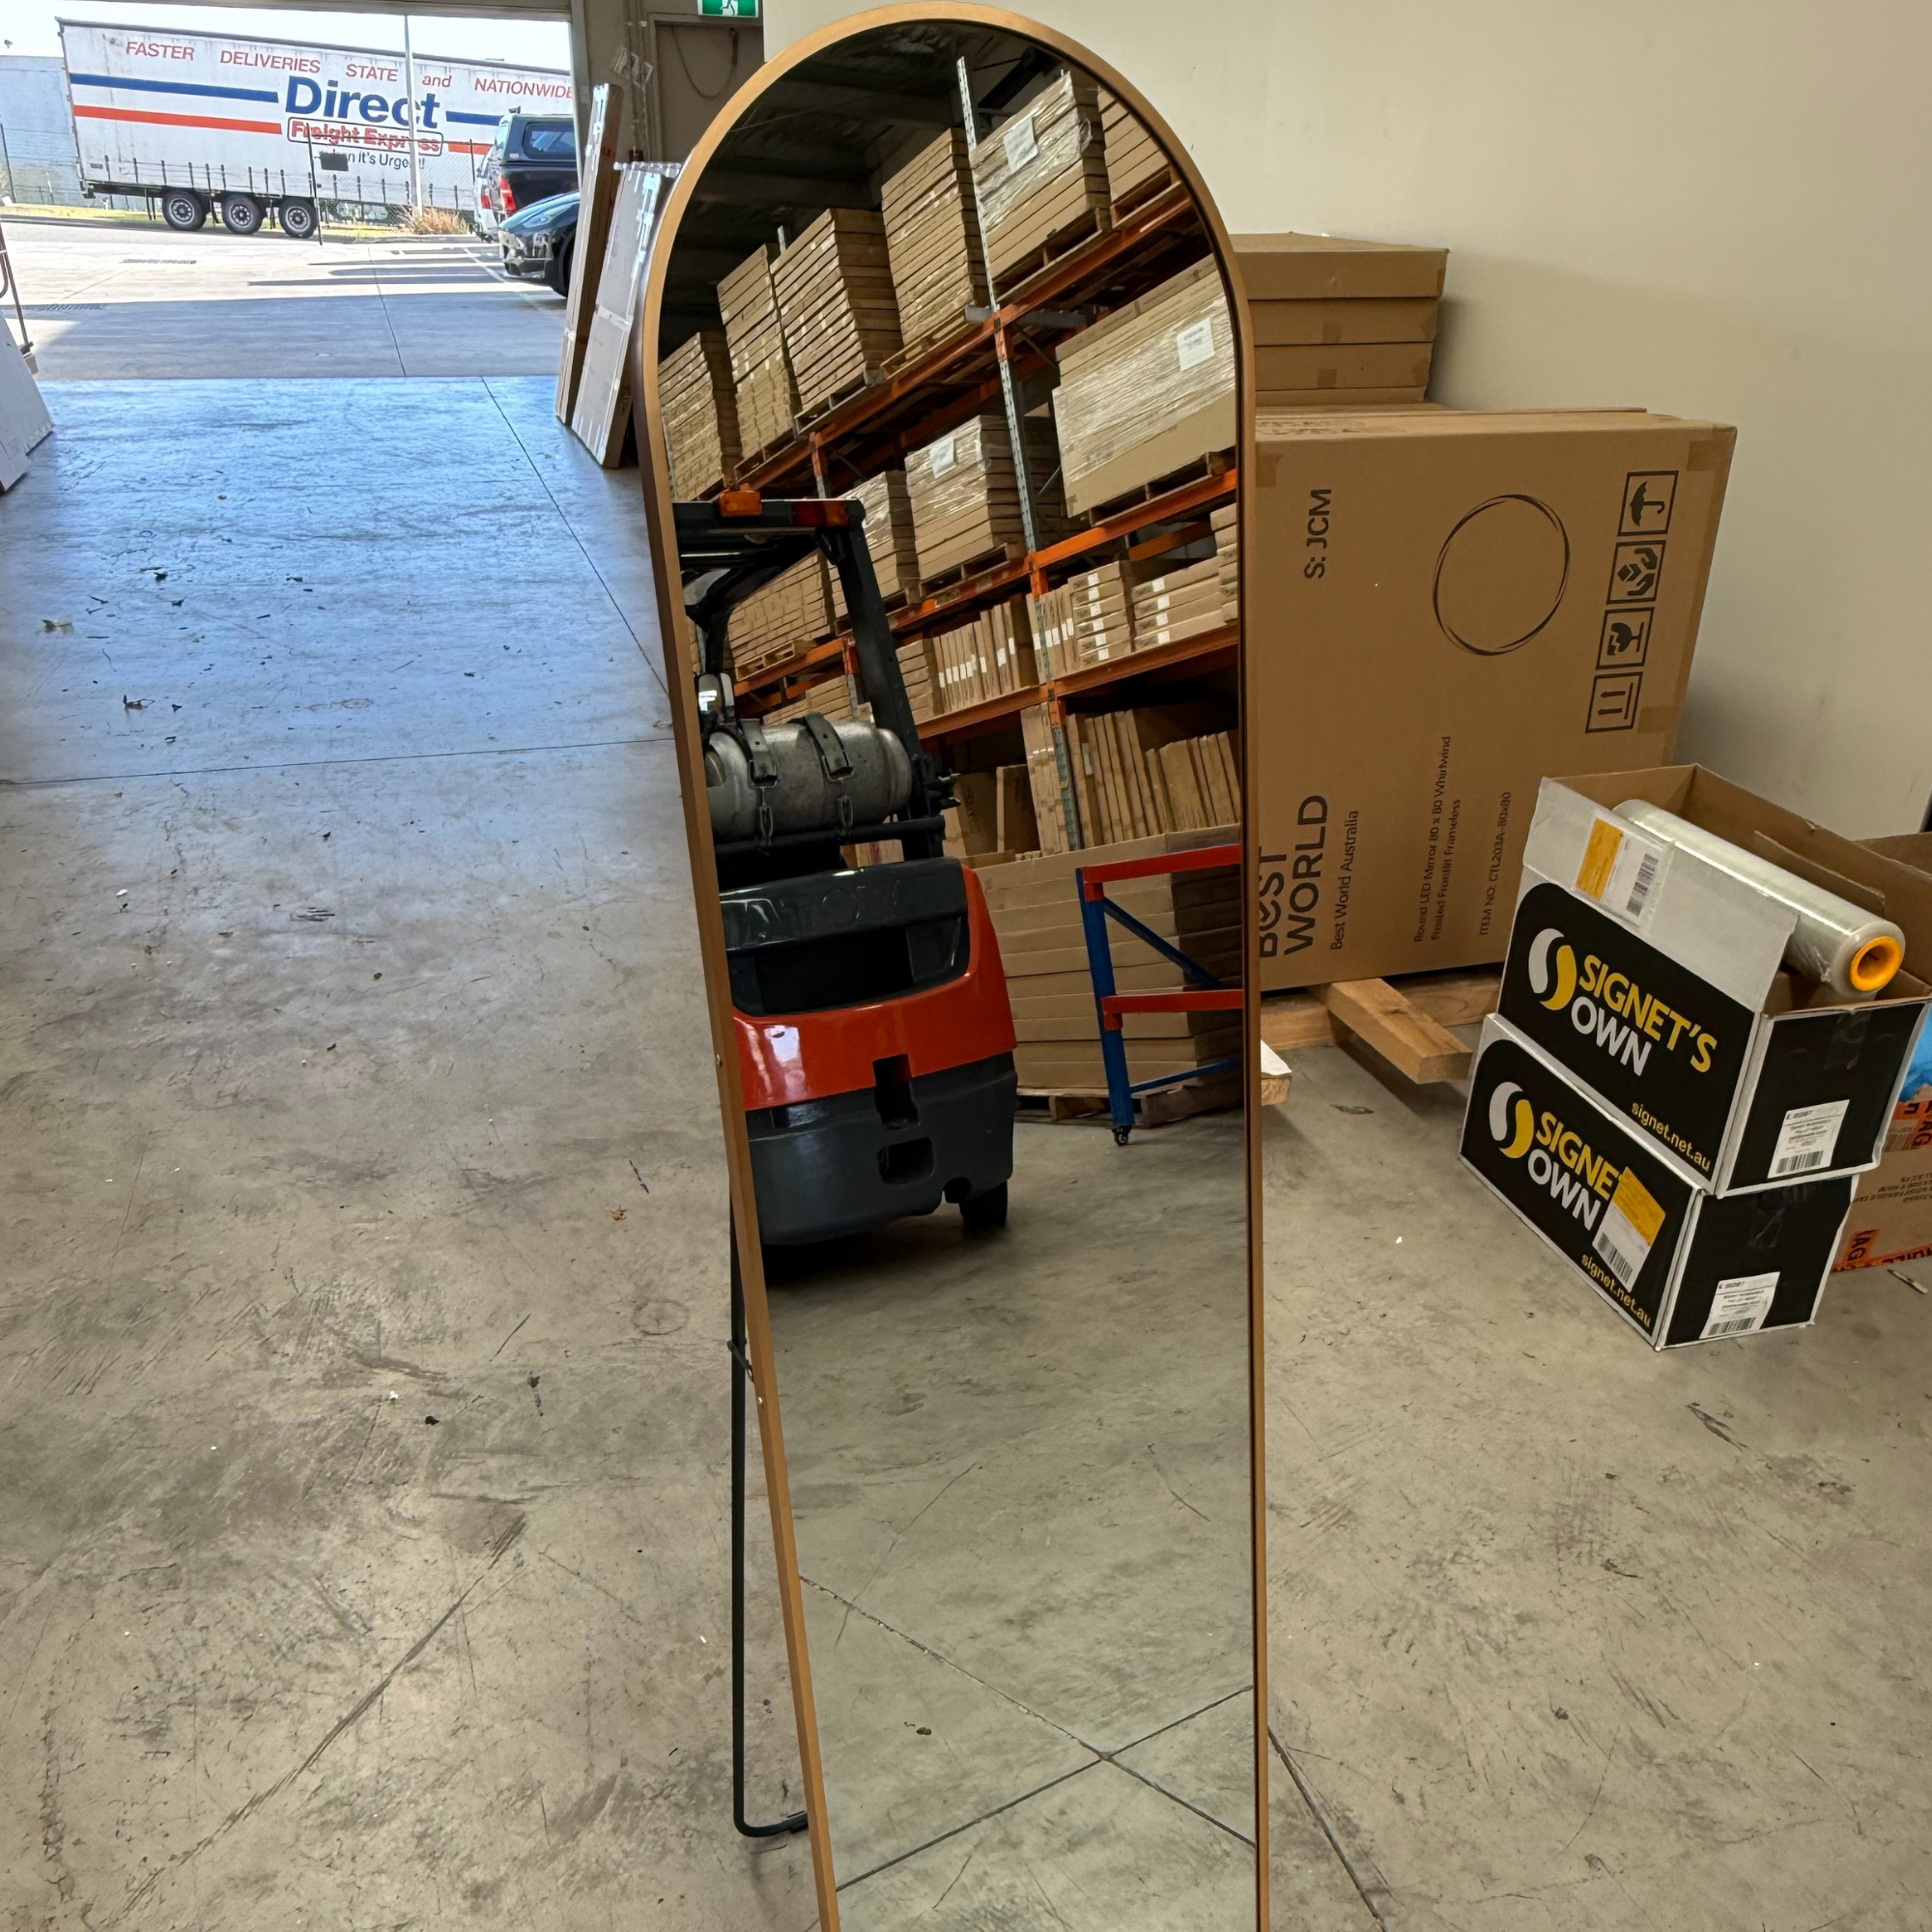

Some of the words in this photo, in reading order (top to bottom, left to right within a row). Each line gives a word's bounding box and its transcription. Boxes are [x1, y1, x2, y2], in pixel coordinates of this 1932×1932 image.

[126, 41, 195, 61] FASTER
[220, 50, 322, 73] DELIVERIES
[346, 64, 399, 82] STATE
[421, 75, 452, 88] and
[474, 77, 573, 99] NATIONWIDE
[285, 75, 440, 128] Direct
[357, 151, 376, 164] It's
[379, 154, 425, 170] Urget!
[363, 128, 440, 152] Exprss
[1306, 489, 1332, 550] JCM
[1303, 556, 1326, 580] S:
[1434, 736, 1451, 798] Whirlwind
[1433, 800, 1443, 814] 80
[1340, 810, 1358, 872] Australia
[1429, 827, 1439, 842] 80
[1284, 795, 1328, 955] WORLD
[1423, 845, 1437, 880] Mirror
[1431, 900, 1446, 941] Frosted
[1444, 799, 1461, 856] Frameless
[1335, 875, 1351, 920] World
[1420, 883, 1432, 904] LED
[1485, 884, 1497, 907] NO:
[1330, 921, 1346, 951] Best
[1413, 906, 1428, 943] Round
[1479, 908, 1492, 936] ITEM
[1571, 996, 1652, 1077] OWN
[1578, 954, 1718, 1073] SIGNET'S
[1536, 1112, 1621, 1201] SIGNE
[1632, 1102, 1711, 1172] signet.net.au
[1528, 1149, 1601, 1231] OWN
[1581, 1255, 1651, 1328] signet.net.au
